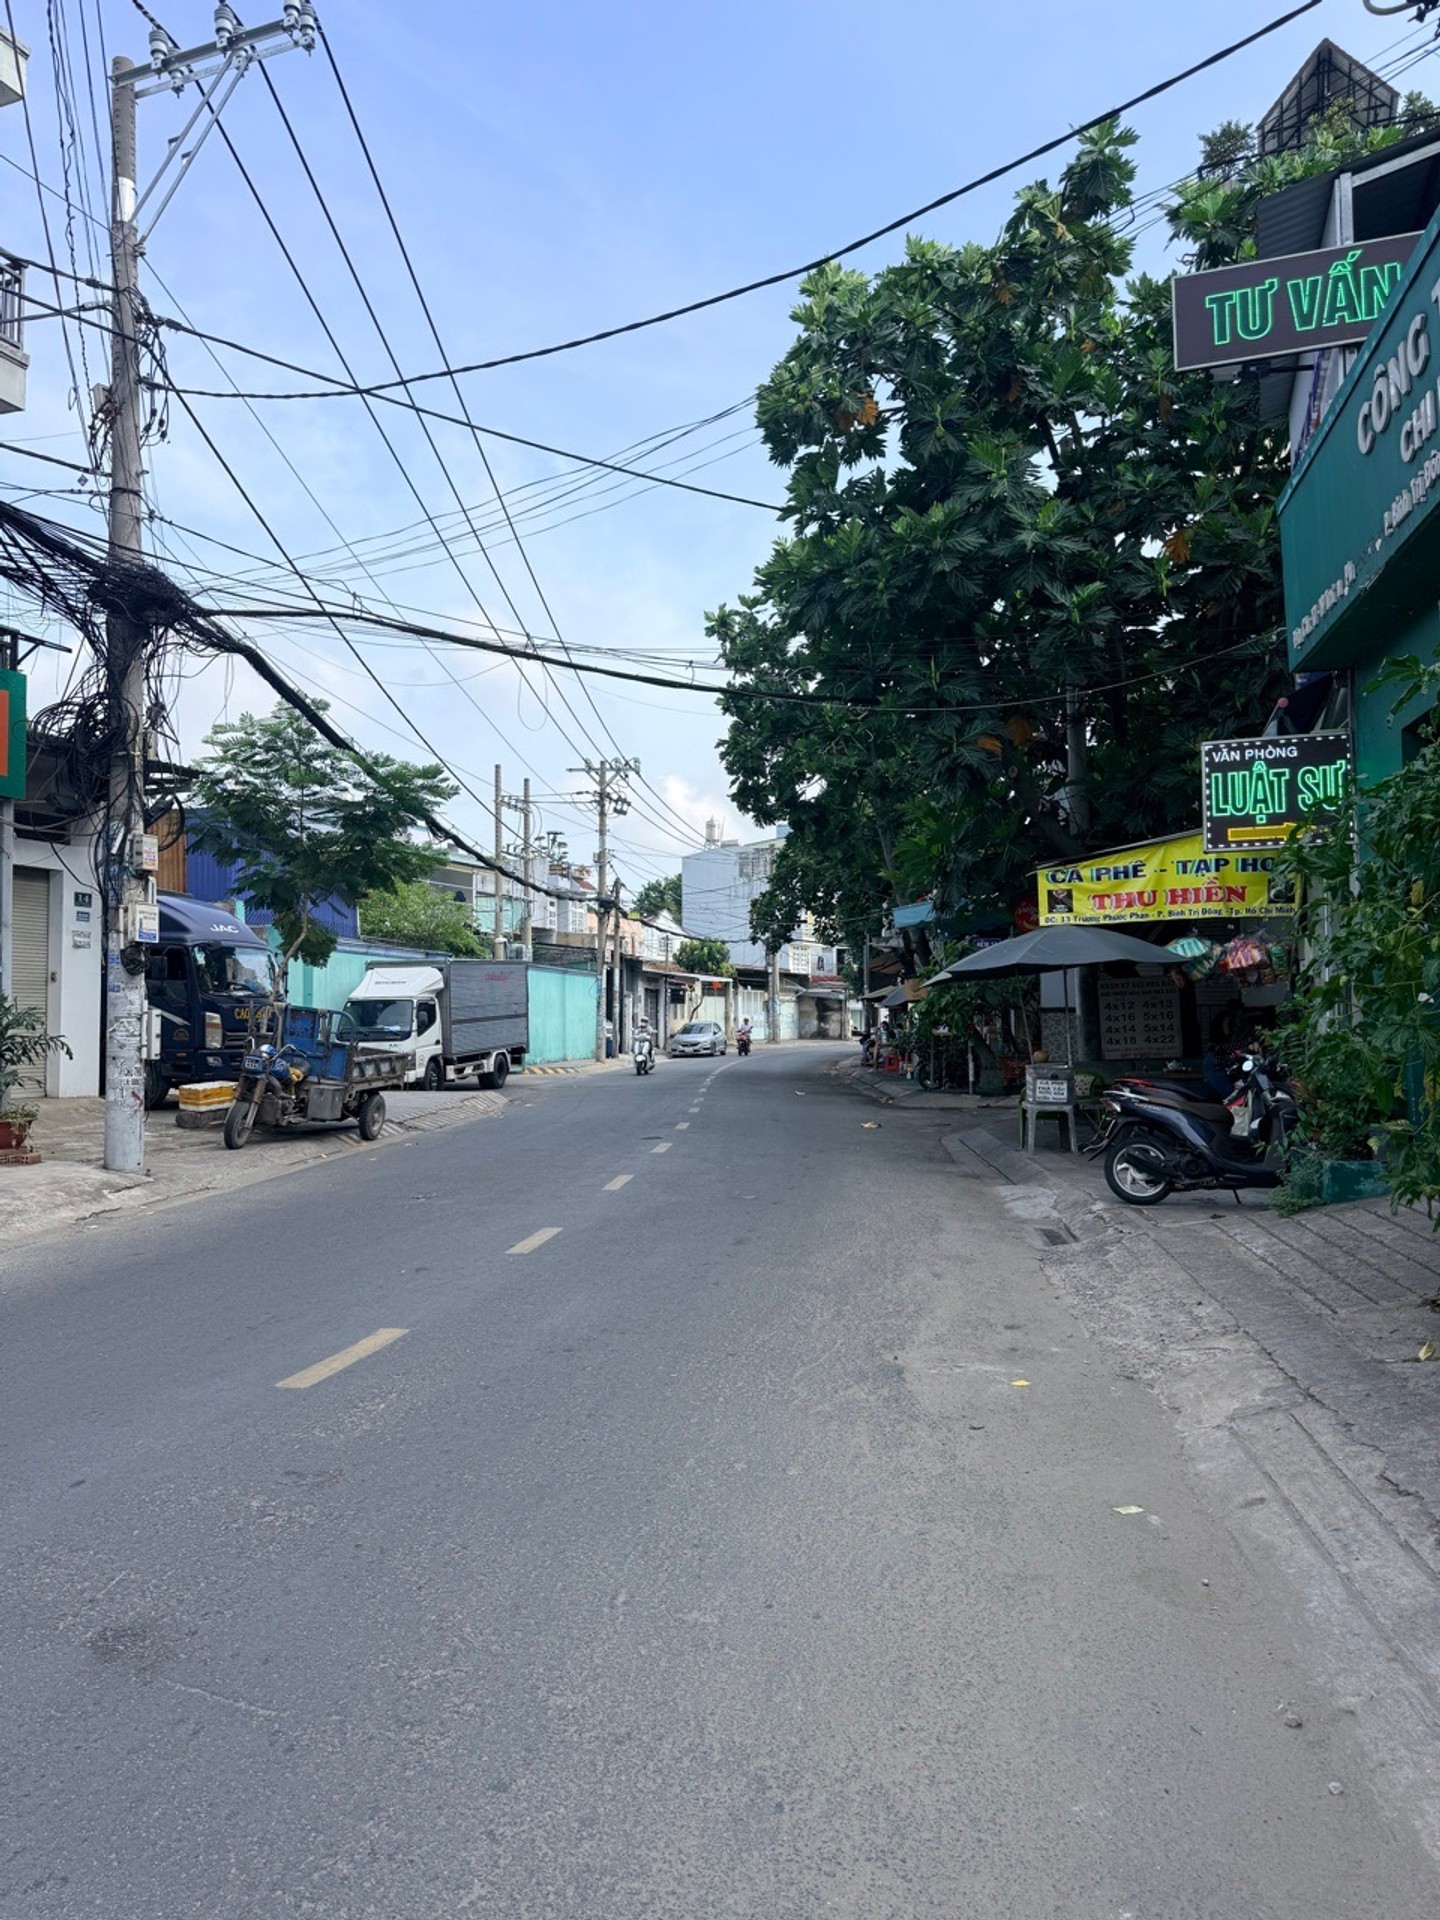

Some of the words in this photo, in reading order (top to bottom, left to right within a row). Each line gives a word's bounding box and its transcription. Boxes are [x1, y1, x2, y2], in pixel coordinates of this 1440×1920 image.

[1205, 278, 1278, 346] TƯ
[1287, 249, 1401, 332] VẤN
[1357, 313, 1431, 455] CÔNG
[1400, 390, 1437, 464] CHI
[1212, 747, 1241, 763] VĂN
[1245, 745, 1298, 761] PHÒNG
[1211, 761, 1289, 824] LUẬT
[1297, 759, 1346, 812] SƯ
[1091, 860, 1146, 881] PHÊ
[1175, 857, 1230, 877] TẠP
[1088, 889, 1158, 911] THU
[1164, 876, 1247, 906] HIỀN
[210, 924, 239, 934] JAC
[1104, 1001, 1135, 1011] 4x12
[1142, 999, 1173, 1009] 4x13
[1105, 1012, 1136, 1022] 4x16
[1105, 1024, 1136, 1034] 4x14
[1144, 1034, 1175, 1044] 4x22
